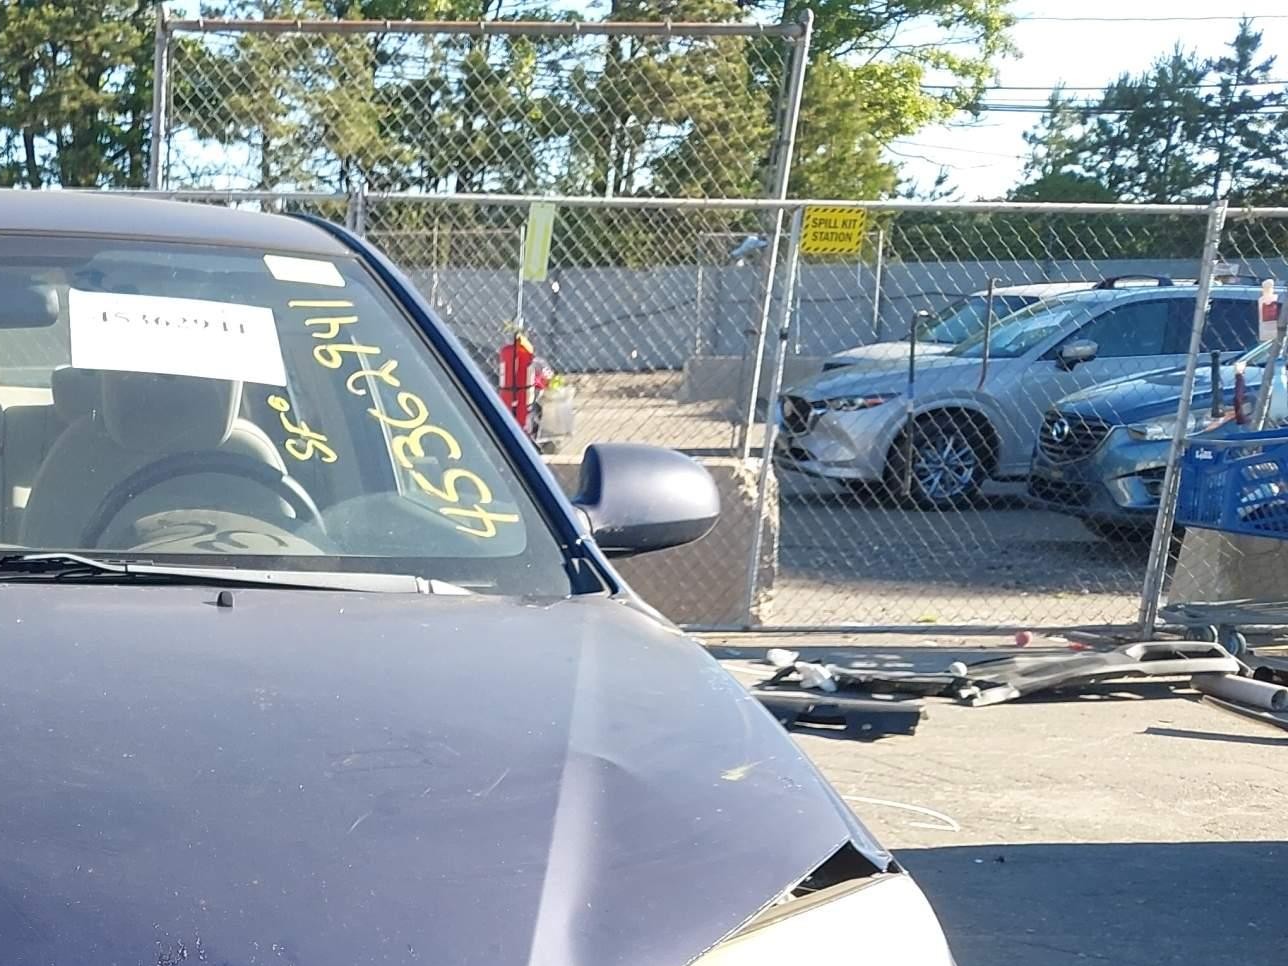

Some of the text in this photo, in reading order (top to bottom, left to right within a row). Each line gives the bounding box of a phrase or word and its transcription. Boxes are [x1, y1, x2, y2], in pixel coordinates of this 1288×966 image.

[811, 217, 858, 229] SPILL KIT
[811, 231, 853, 242] STATION
[288, 300, 520, 538] 45362941
